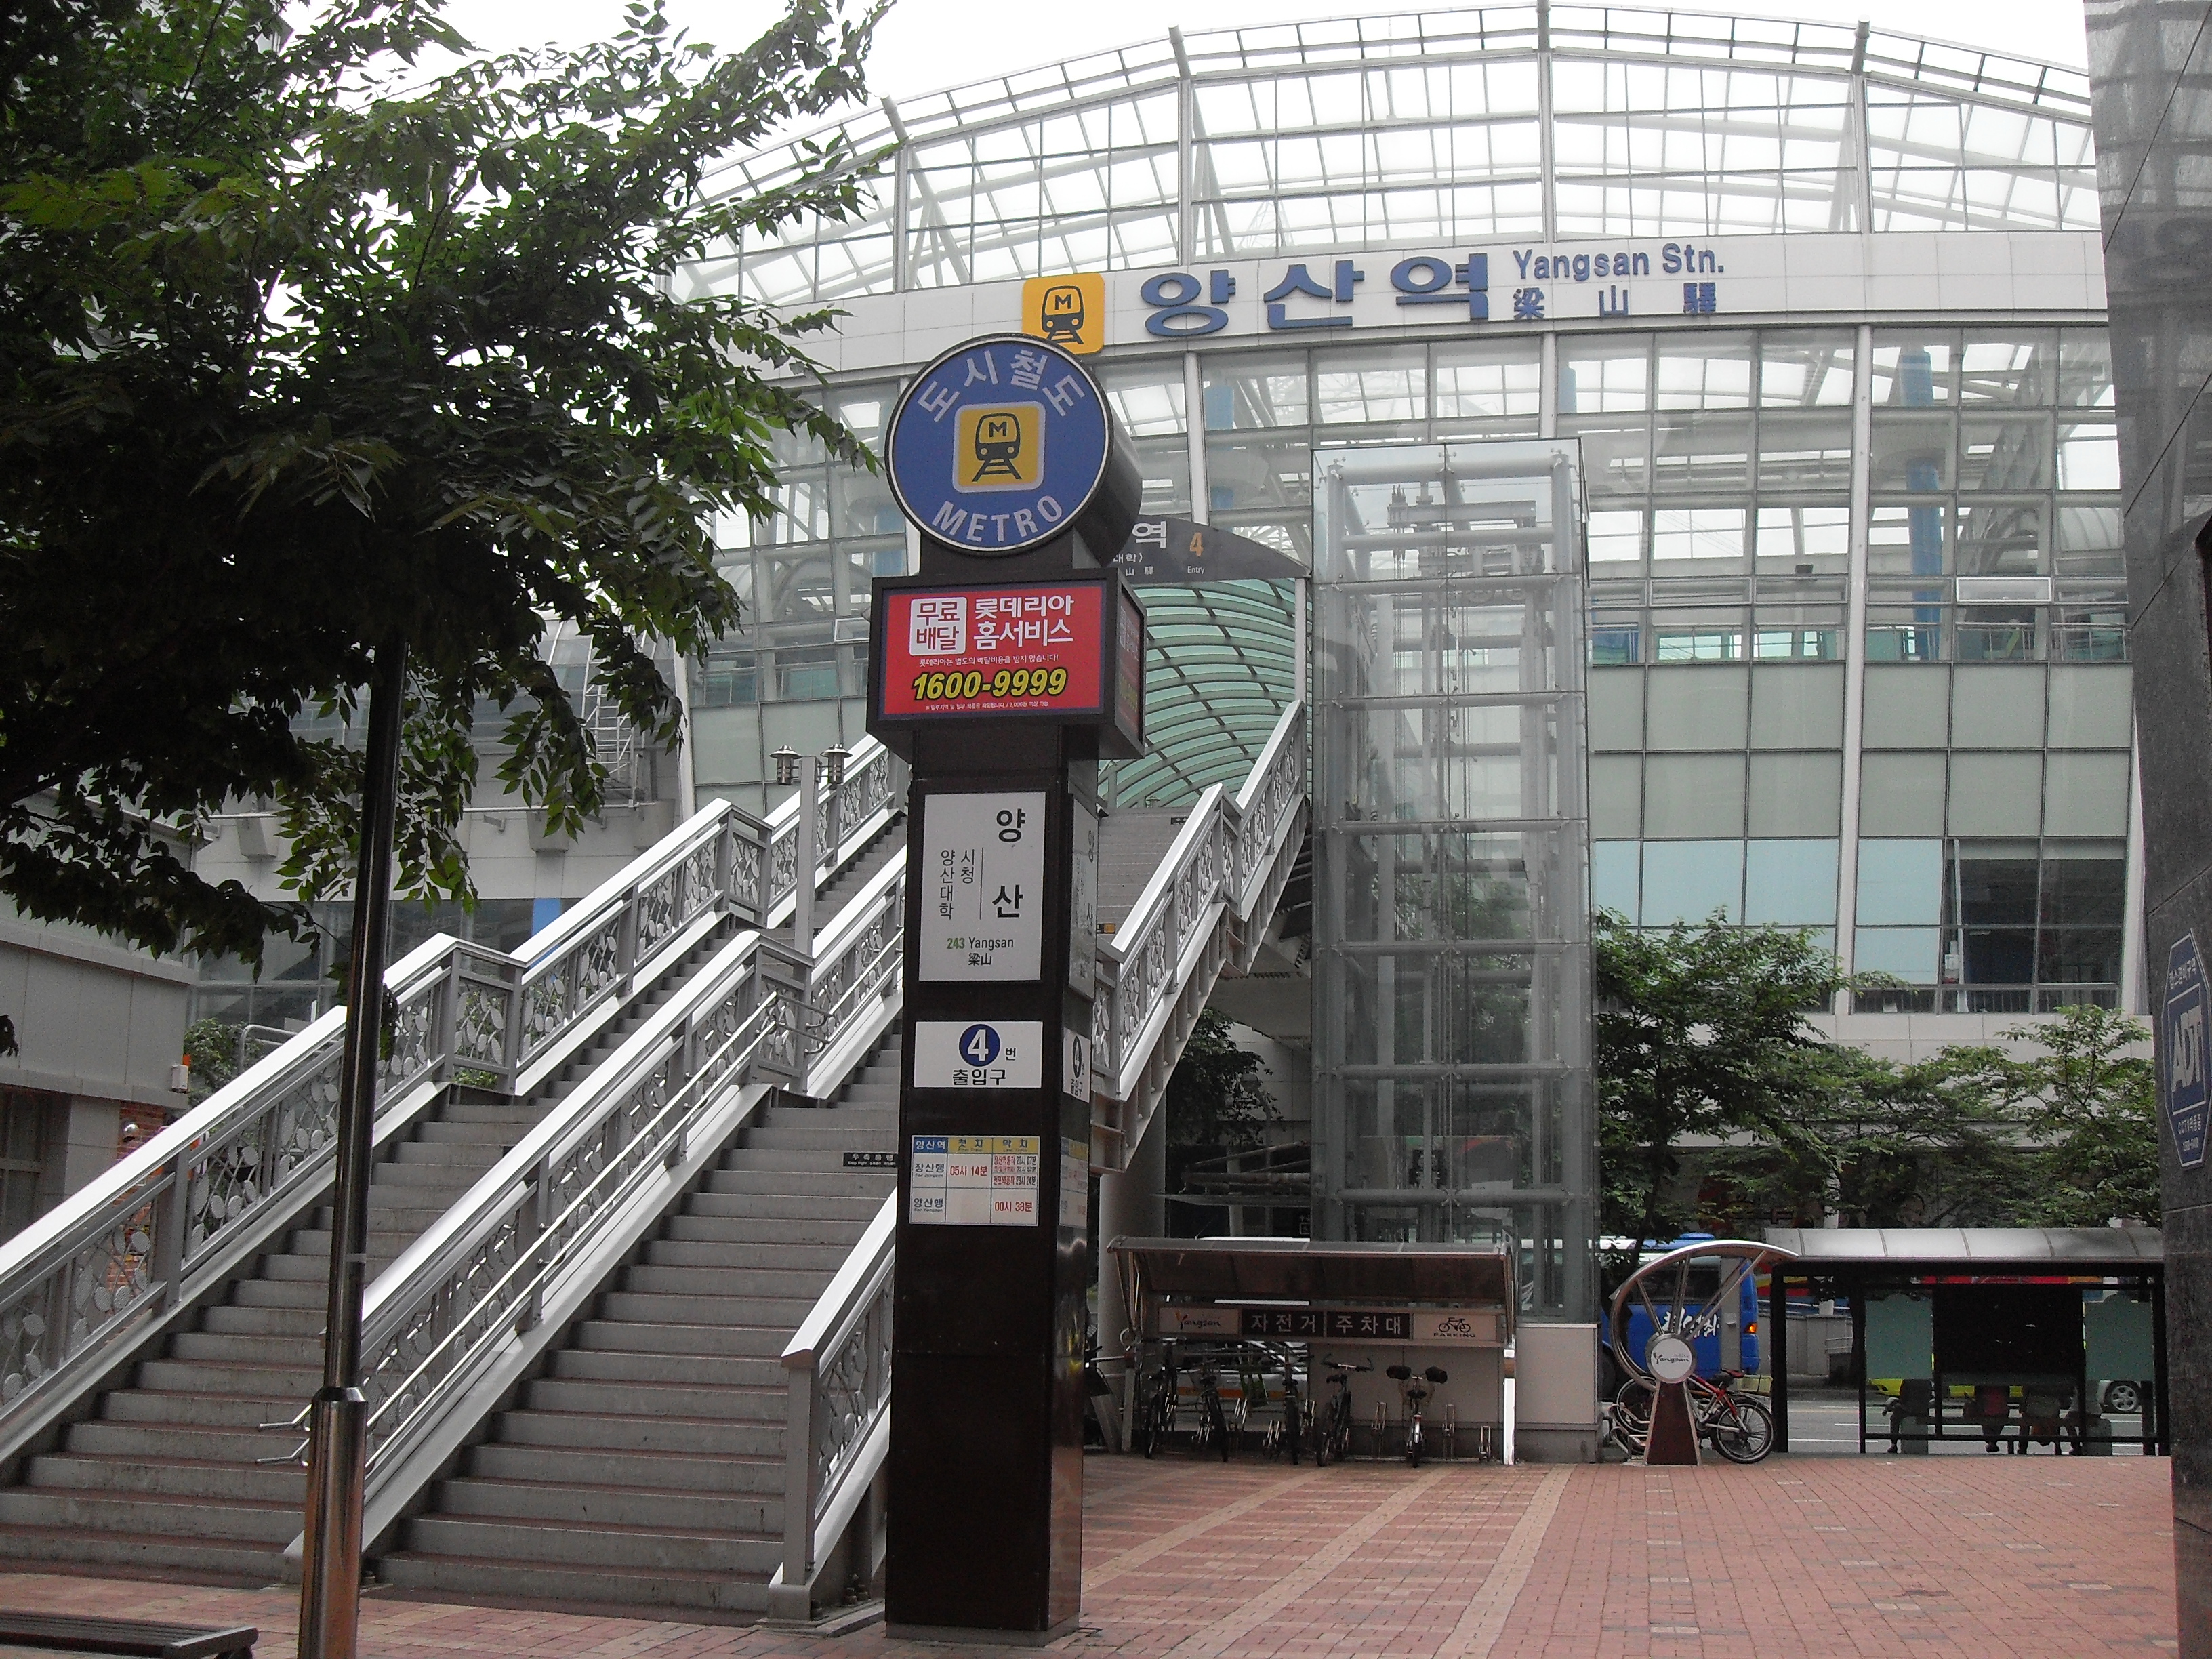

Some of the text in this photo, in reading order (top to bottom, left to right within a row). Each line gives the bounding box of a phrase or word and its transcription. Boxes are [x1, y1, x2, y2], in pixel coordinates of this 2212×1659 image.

[1513, 242, 1724, 281] Yangsan Stn.
[1054, 293, 1072, 310] M
[1140, 252, 1489, 337] 양산역
[917, 350, 1085, 422] 도시철도
[989, 421, 1007, 438] M
[932, 495, 1063, 541] METRO
[1131, 520, 1166, 549] 역
[1189, 532, 1204, 557] 4
[1187, 565, 1205, 575] Entry
[916, 600, 960, 626] 무료
[975, 594, 1075, 620] 롯데리아
[916, 626, 960, 651] 배달
[973, 619, 1074, 651] 홈서비스
[913, 668, 1068, 700] 1600-9999
[960, 849, 975, 884] 시청
[939, 849, 956, 920] 양산대학
[947, 937, 1014, 951] 243 Yangsan
[968, 953, 992, 966] 梁山
[967, 1029, 1016, 1062] 4 번
[2171, 1005, 2202, 1092] ADT
[952, 1069, 1006, 1086] 출입구
[916, 1140, 945, 1150] 양산역
[915, 1163, 945, 1173] 장산행
[950, 1166, 967, 1176] 05시
[971, 1166, 987, 1176] 14분
[914, 1197, 943, 1208] 양산행
[994, 1202, 1033, 1212] 00시 38분
[1250, 1313, 1401, 1335] 자전거 주차대
[1653, 1352, 1690, 1365] Yangsan
